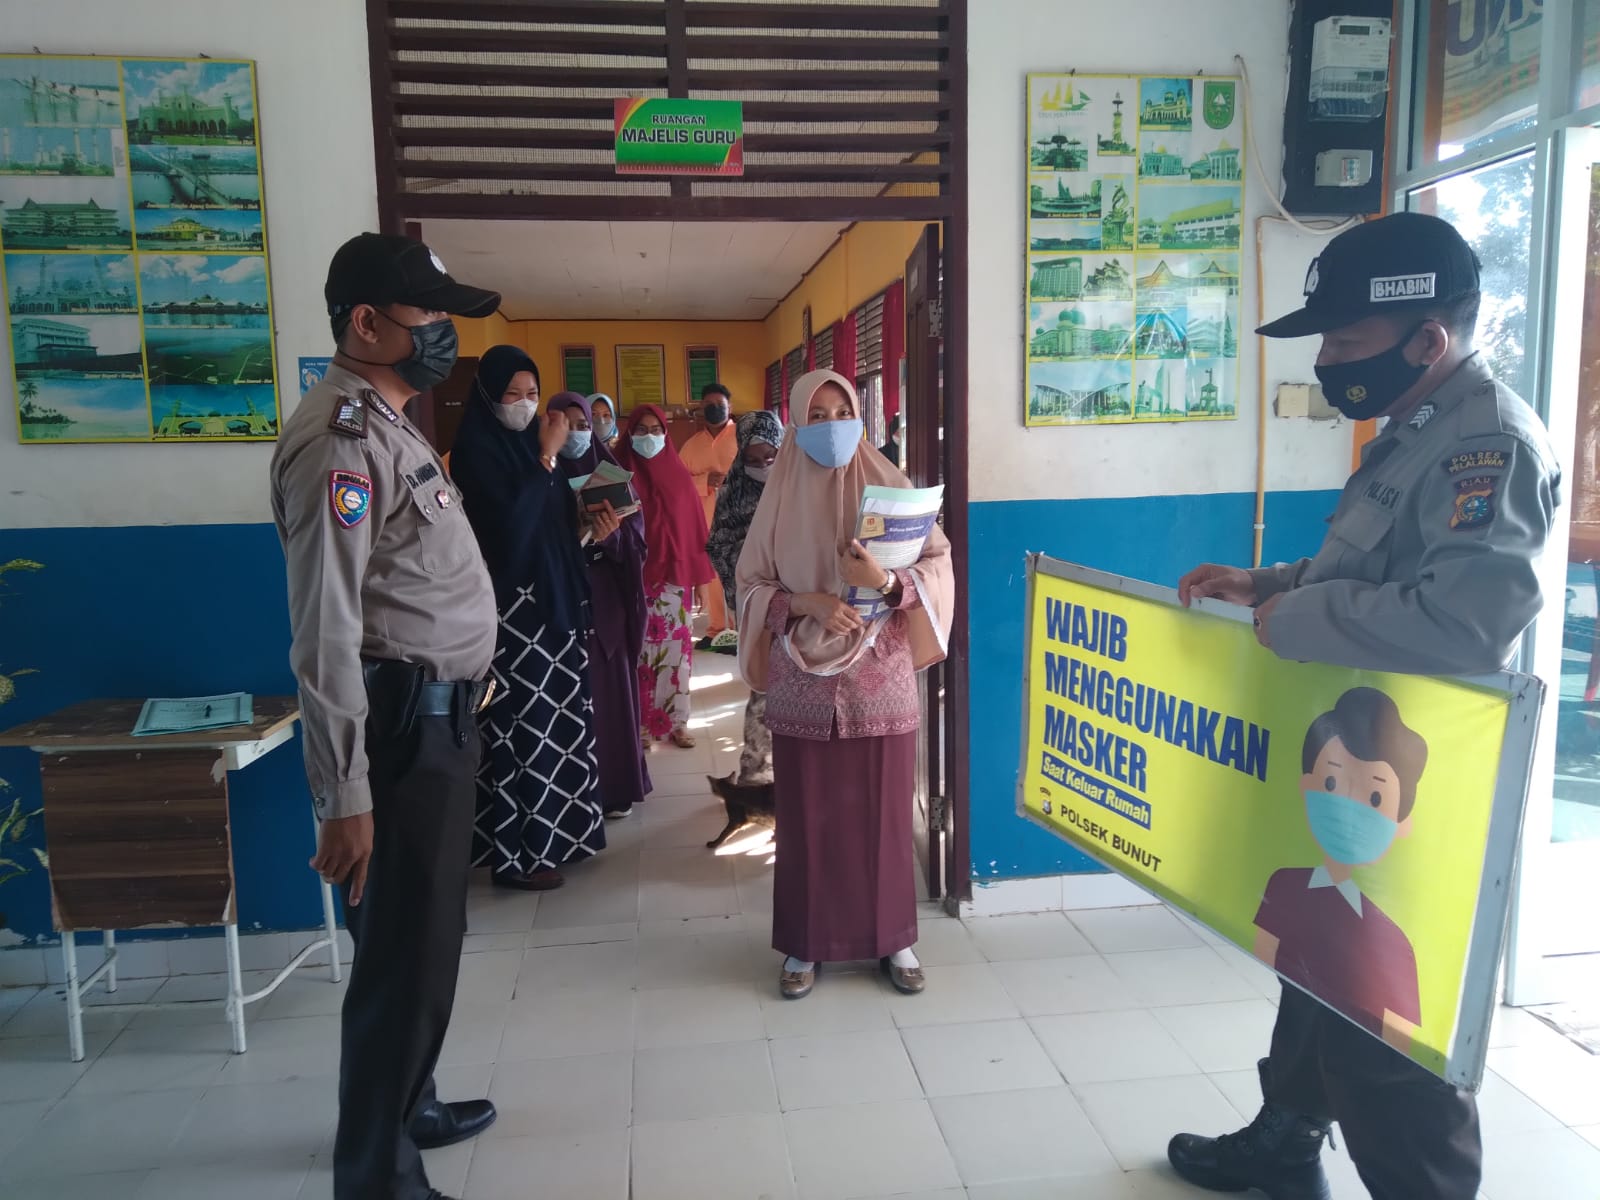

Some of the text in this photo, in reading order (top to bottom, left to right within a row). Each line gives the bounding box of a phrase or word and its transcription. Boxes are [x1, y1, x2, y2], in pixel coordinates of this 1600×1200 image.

[652, 114, 706, 125] RUANGAN
[622, 127, 736, 145] MAJELIS GURU
[1375, 278, 1430, 298] BHABIN
[1448, 458, 1505, 473] PELALAWAN
[1451, 451, 1501, 465] POLRES
[1460, 477, 1491, 488] RIAU
[1046, 596, 1128, 662] WAJIB
[1045, 651, 1270, 783] MENGGUNAKAN
[1043, 704, 1147, 793] MASKER
[1043, 755, 1149, 825] Saat Keluar Rumah
[1060, 804, 1162, 872] POLSEK BUNUT
